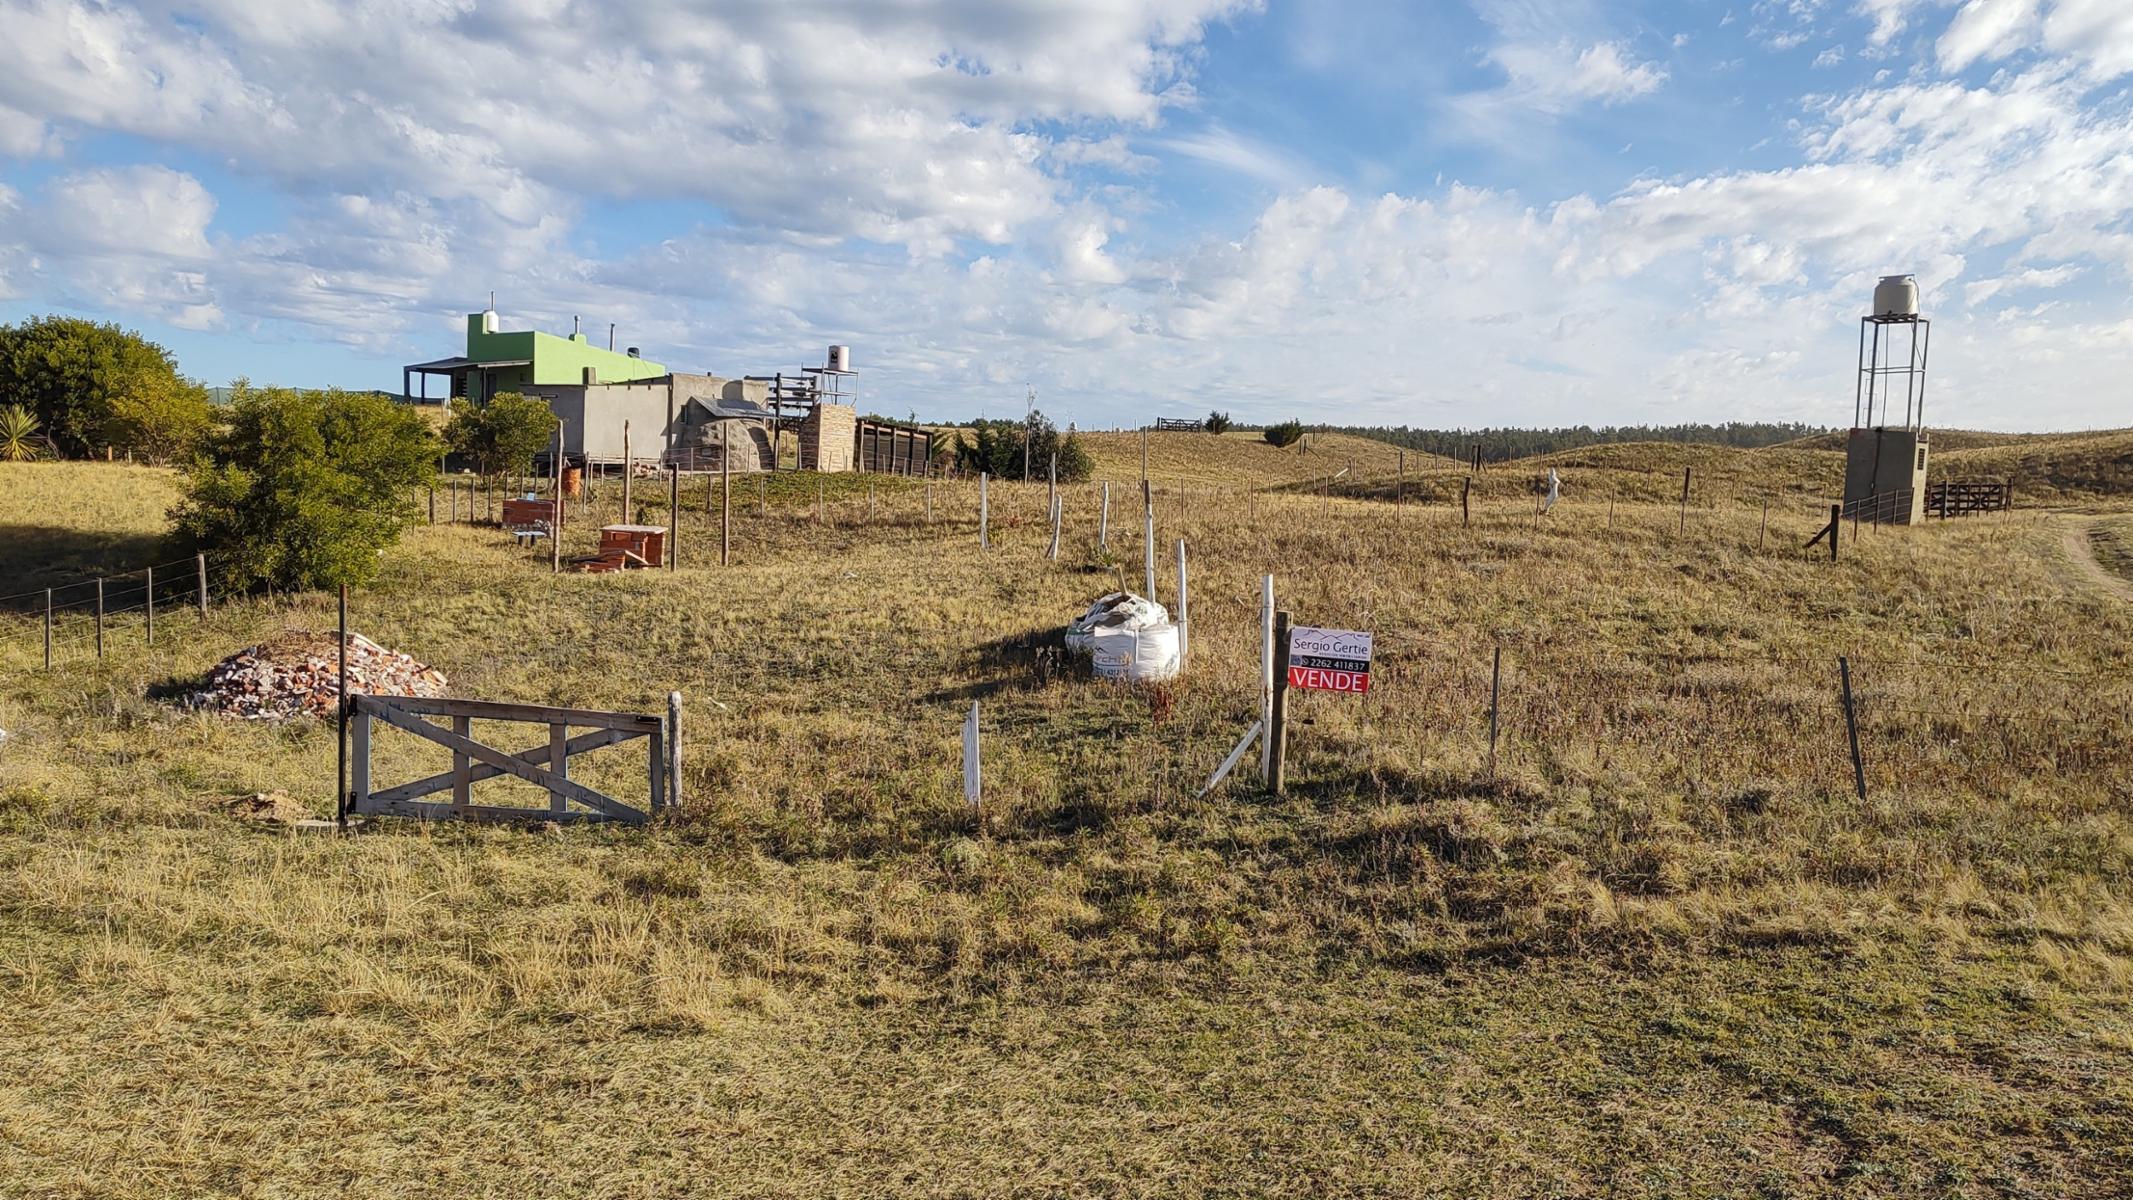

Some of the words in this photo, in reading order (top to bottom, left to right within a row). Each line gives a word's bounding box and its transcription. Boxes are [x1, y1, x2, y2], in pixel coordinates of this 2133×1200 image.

[1294, 639, 1330, 653] Sergio
[1333, 642, 1368, 654] Gertie
[1311, 659, 1332, 668] 2262
[1335, 661, 1365, 671] 411837
[1293, 669, 1363, 692] VENDE
